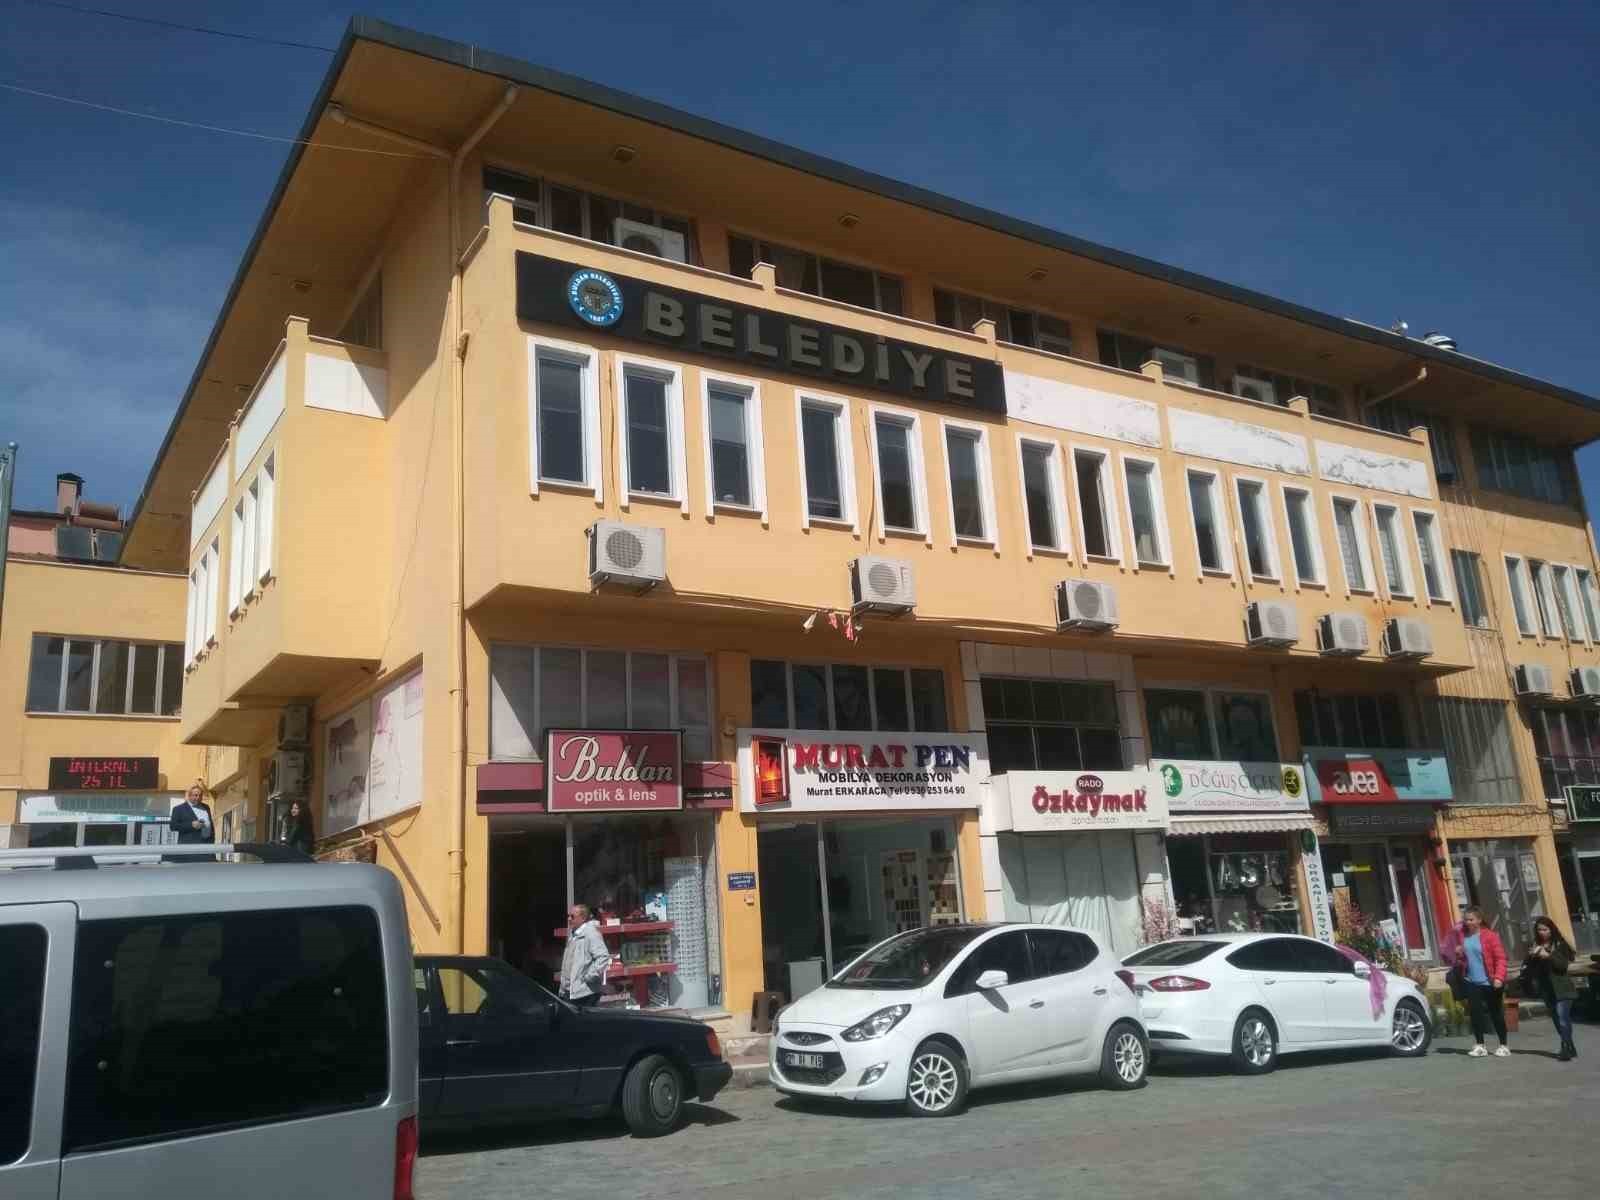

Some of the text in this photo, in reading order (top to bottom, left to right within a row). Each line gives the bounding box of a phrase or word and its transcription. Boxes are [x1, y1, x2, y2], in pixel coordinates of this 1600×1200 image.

[643, 290, 976, 398] BELEDİYE
[555, 736, 673, 782] Buldan
[793, 743, 970, 768] MURAT PEN
[875, 771, 952, 783] DEKORASYON
[575, 788, 657, 804] optik & lens
[806, 787, 833, 796] Murat
[1031, 785, 1148, 817] Özkaymak
